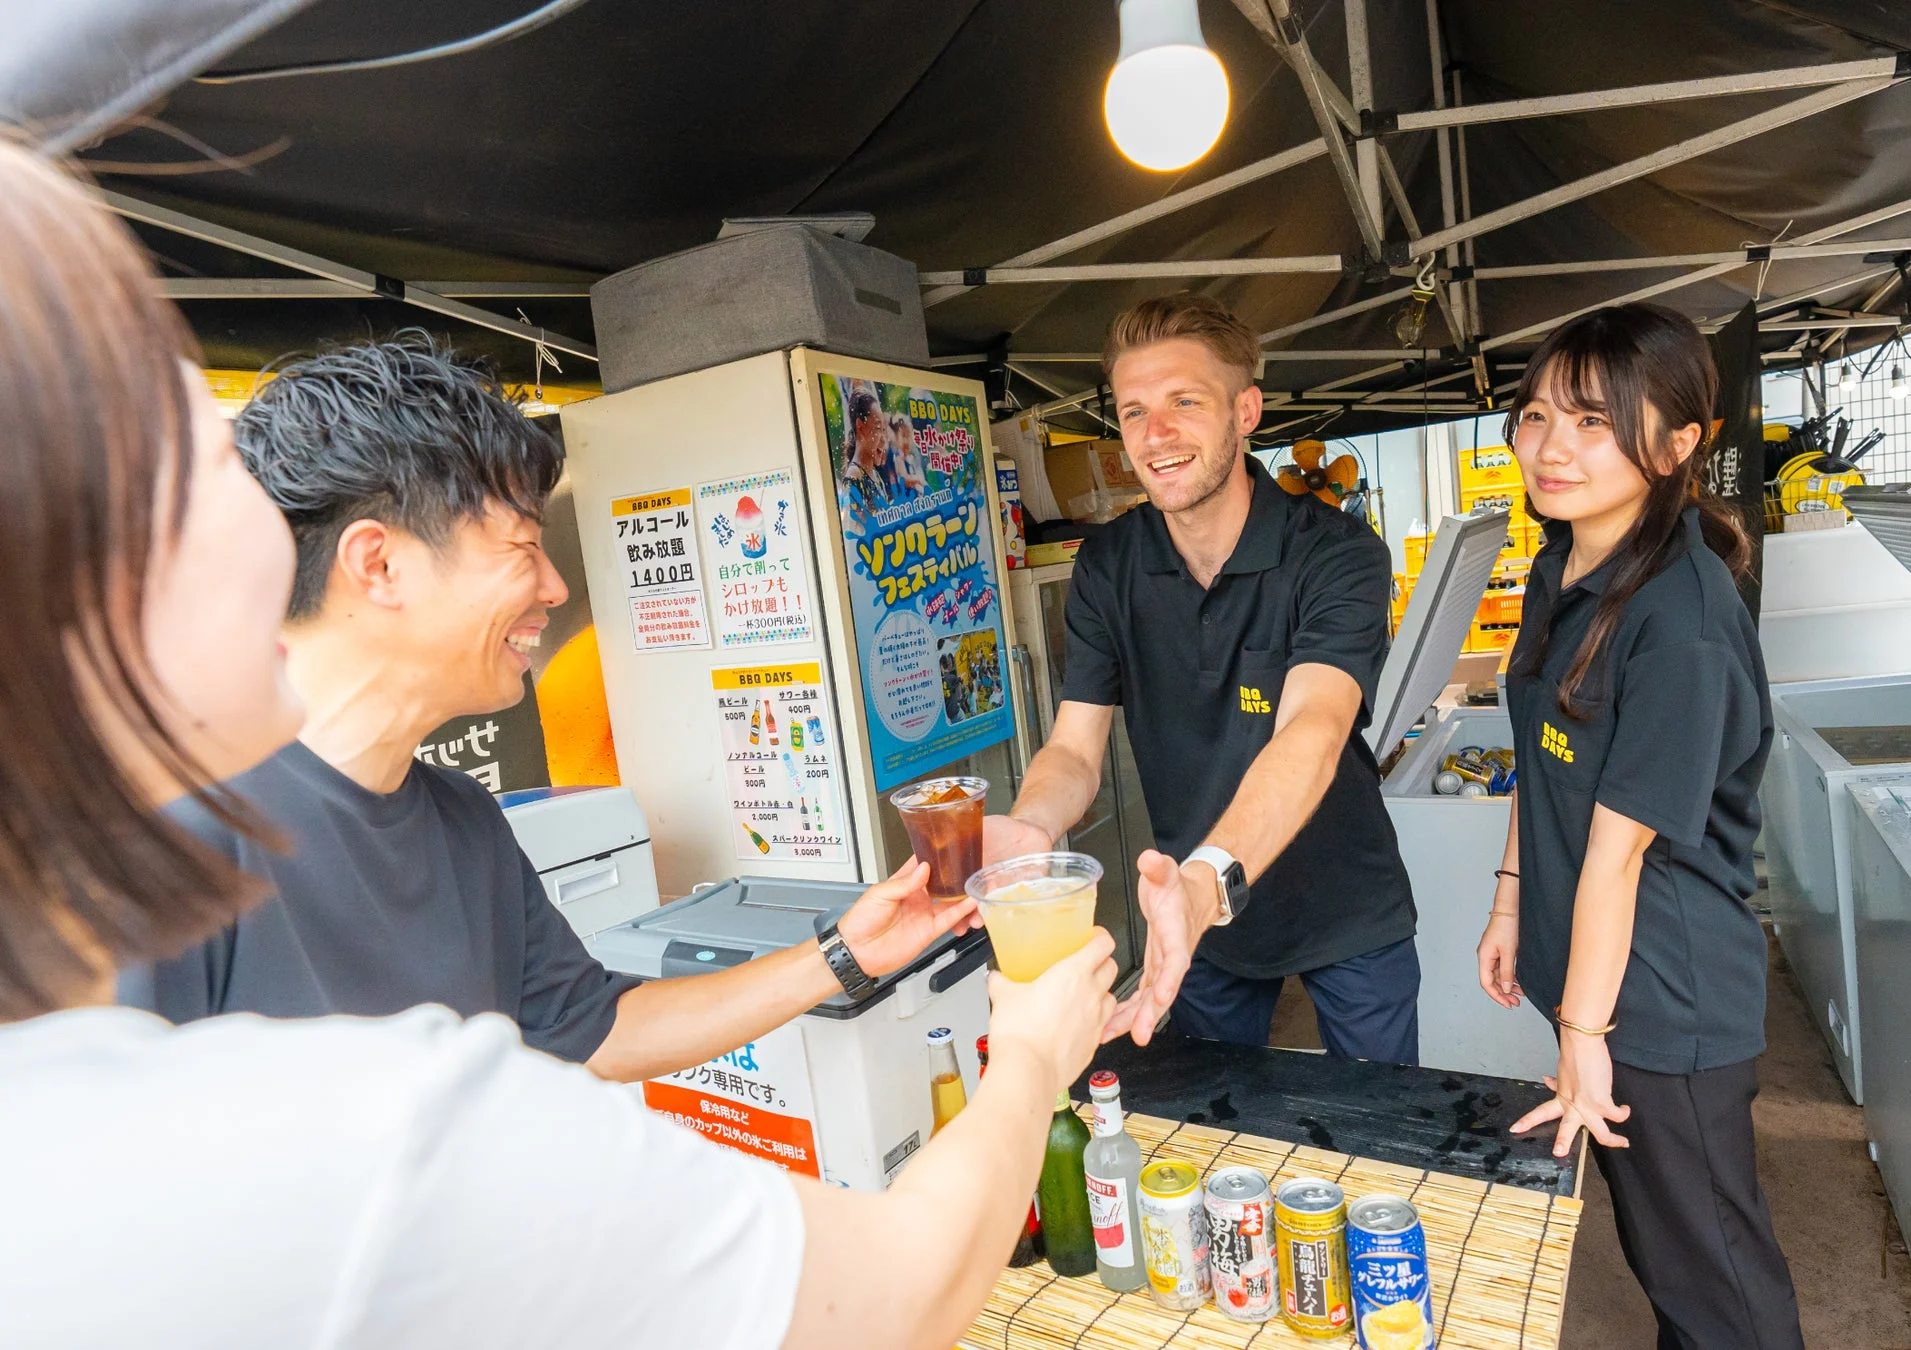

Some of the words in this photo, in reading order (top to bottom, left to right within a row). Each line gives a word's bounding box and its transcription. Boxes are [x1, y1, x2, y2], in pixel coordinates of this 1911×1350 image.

[909, 400, 936, 420] BBQ
[940, 404, 971, 424] DAYS
[632, 500, 649, 511] BBQ
[651, 496, 672, 508] DAYS
[616, 511, 690, 538] アルコール
[745, 533, 761, 551] 氷
[859, 502, 978, 576] ソンクラーン
[626, 537, 686, 563] 飲み放題
[631, 562, 694, 586] 1400円
[718, 557, 790, 580] 自分で削って
[878, 543, 978, 605] フェスティバル
[739, 673, 761, 685] BBQ
[765, 671, 793, 683] DAYS
[725, 711, 746, 721] 500円
[788, 704, 811, 714] 400円
[1240, 698, 1272, 714] DAYS
[1543, 721, 1568, 748] BBQ
[728, 750, 777, 760] ノンアルコール
[804, 754, 827, 763] ラムネ
[1541, 734, 1575, 763] DAYS
[744, 766, 765, 774] ビール
[806, 769, 829, 779] 200円
[700, 1099, 750, 1126] 保冷用など
